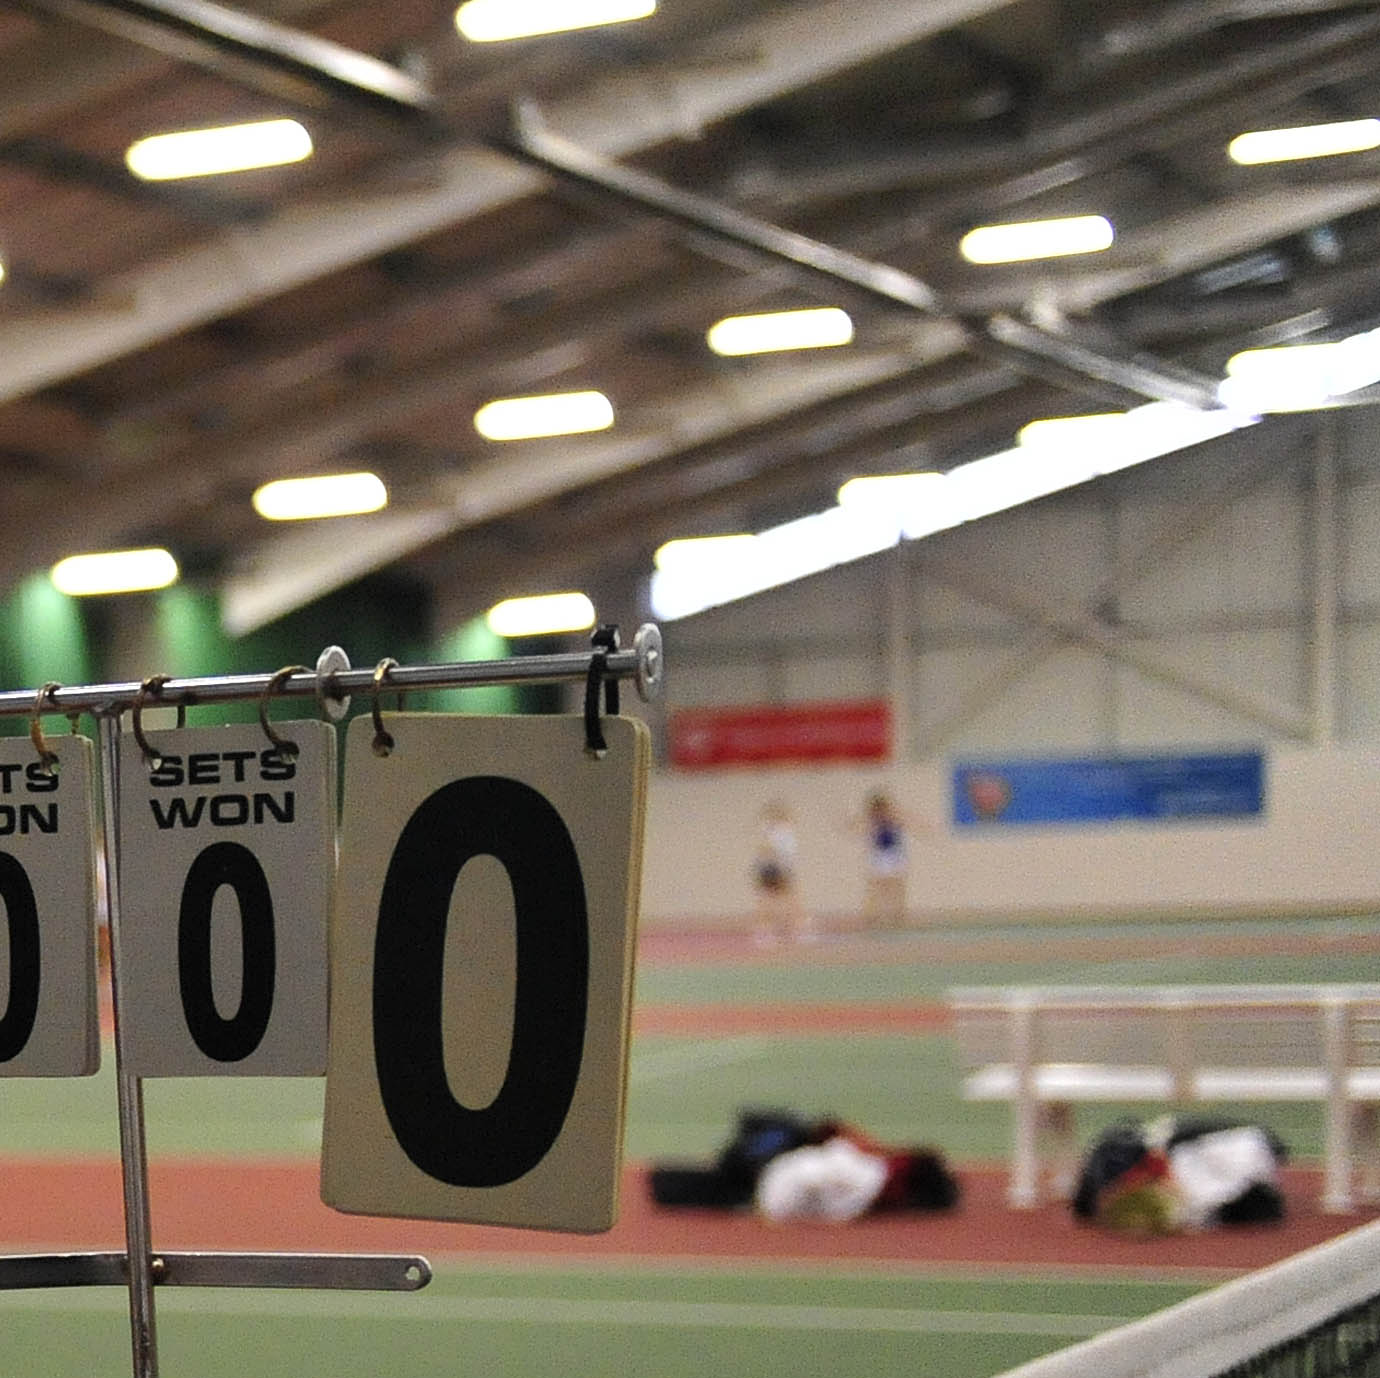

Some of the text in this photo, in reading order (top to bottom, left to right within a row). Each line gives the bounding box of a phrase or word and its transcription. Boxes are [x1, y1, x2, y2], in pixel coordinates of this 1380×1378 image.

[149, 750, 297, 787] SETS
[149, 791, 295, 829] WON
[178, 841, 275, 1062] 0
[372, 775, 589, 1188] 0
